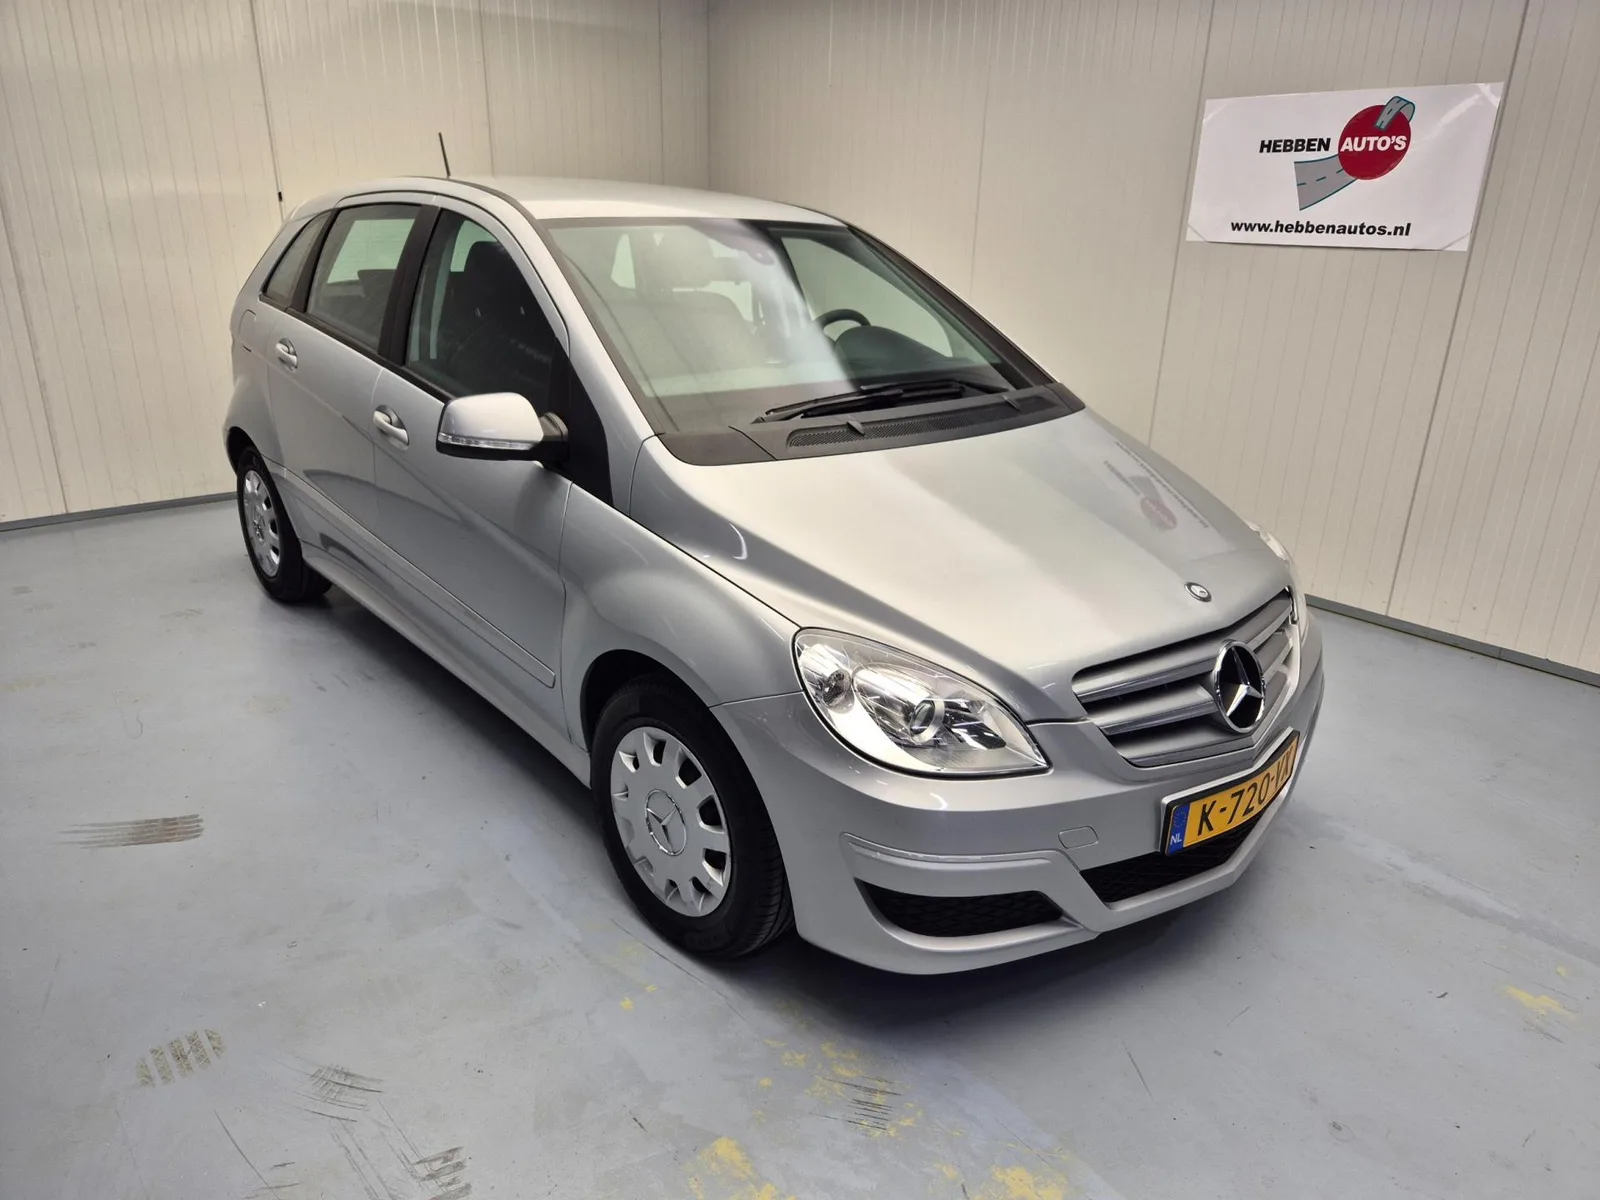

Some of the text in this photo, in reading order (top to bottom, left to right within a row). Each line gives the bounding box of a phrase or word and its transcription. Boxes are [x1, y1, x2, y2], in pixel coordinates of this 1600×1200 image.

[1259, 135, 1407, 153] HEBBEN AUTO'S
[1230, 220, 1411, 236] www.hebbenautos.nl
[1170, 833, 1182, 845] NL
